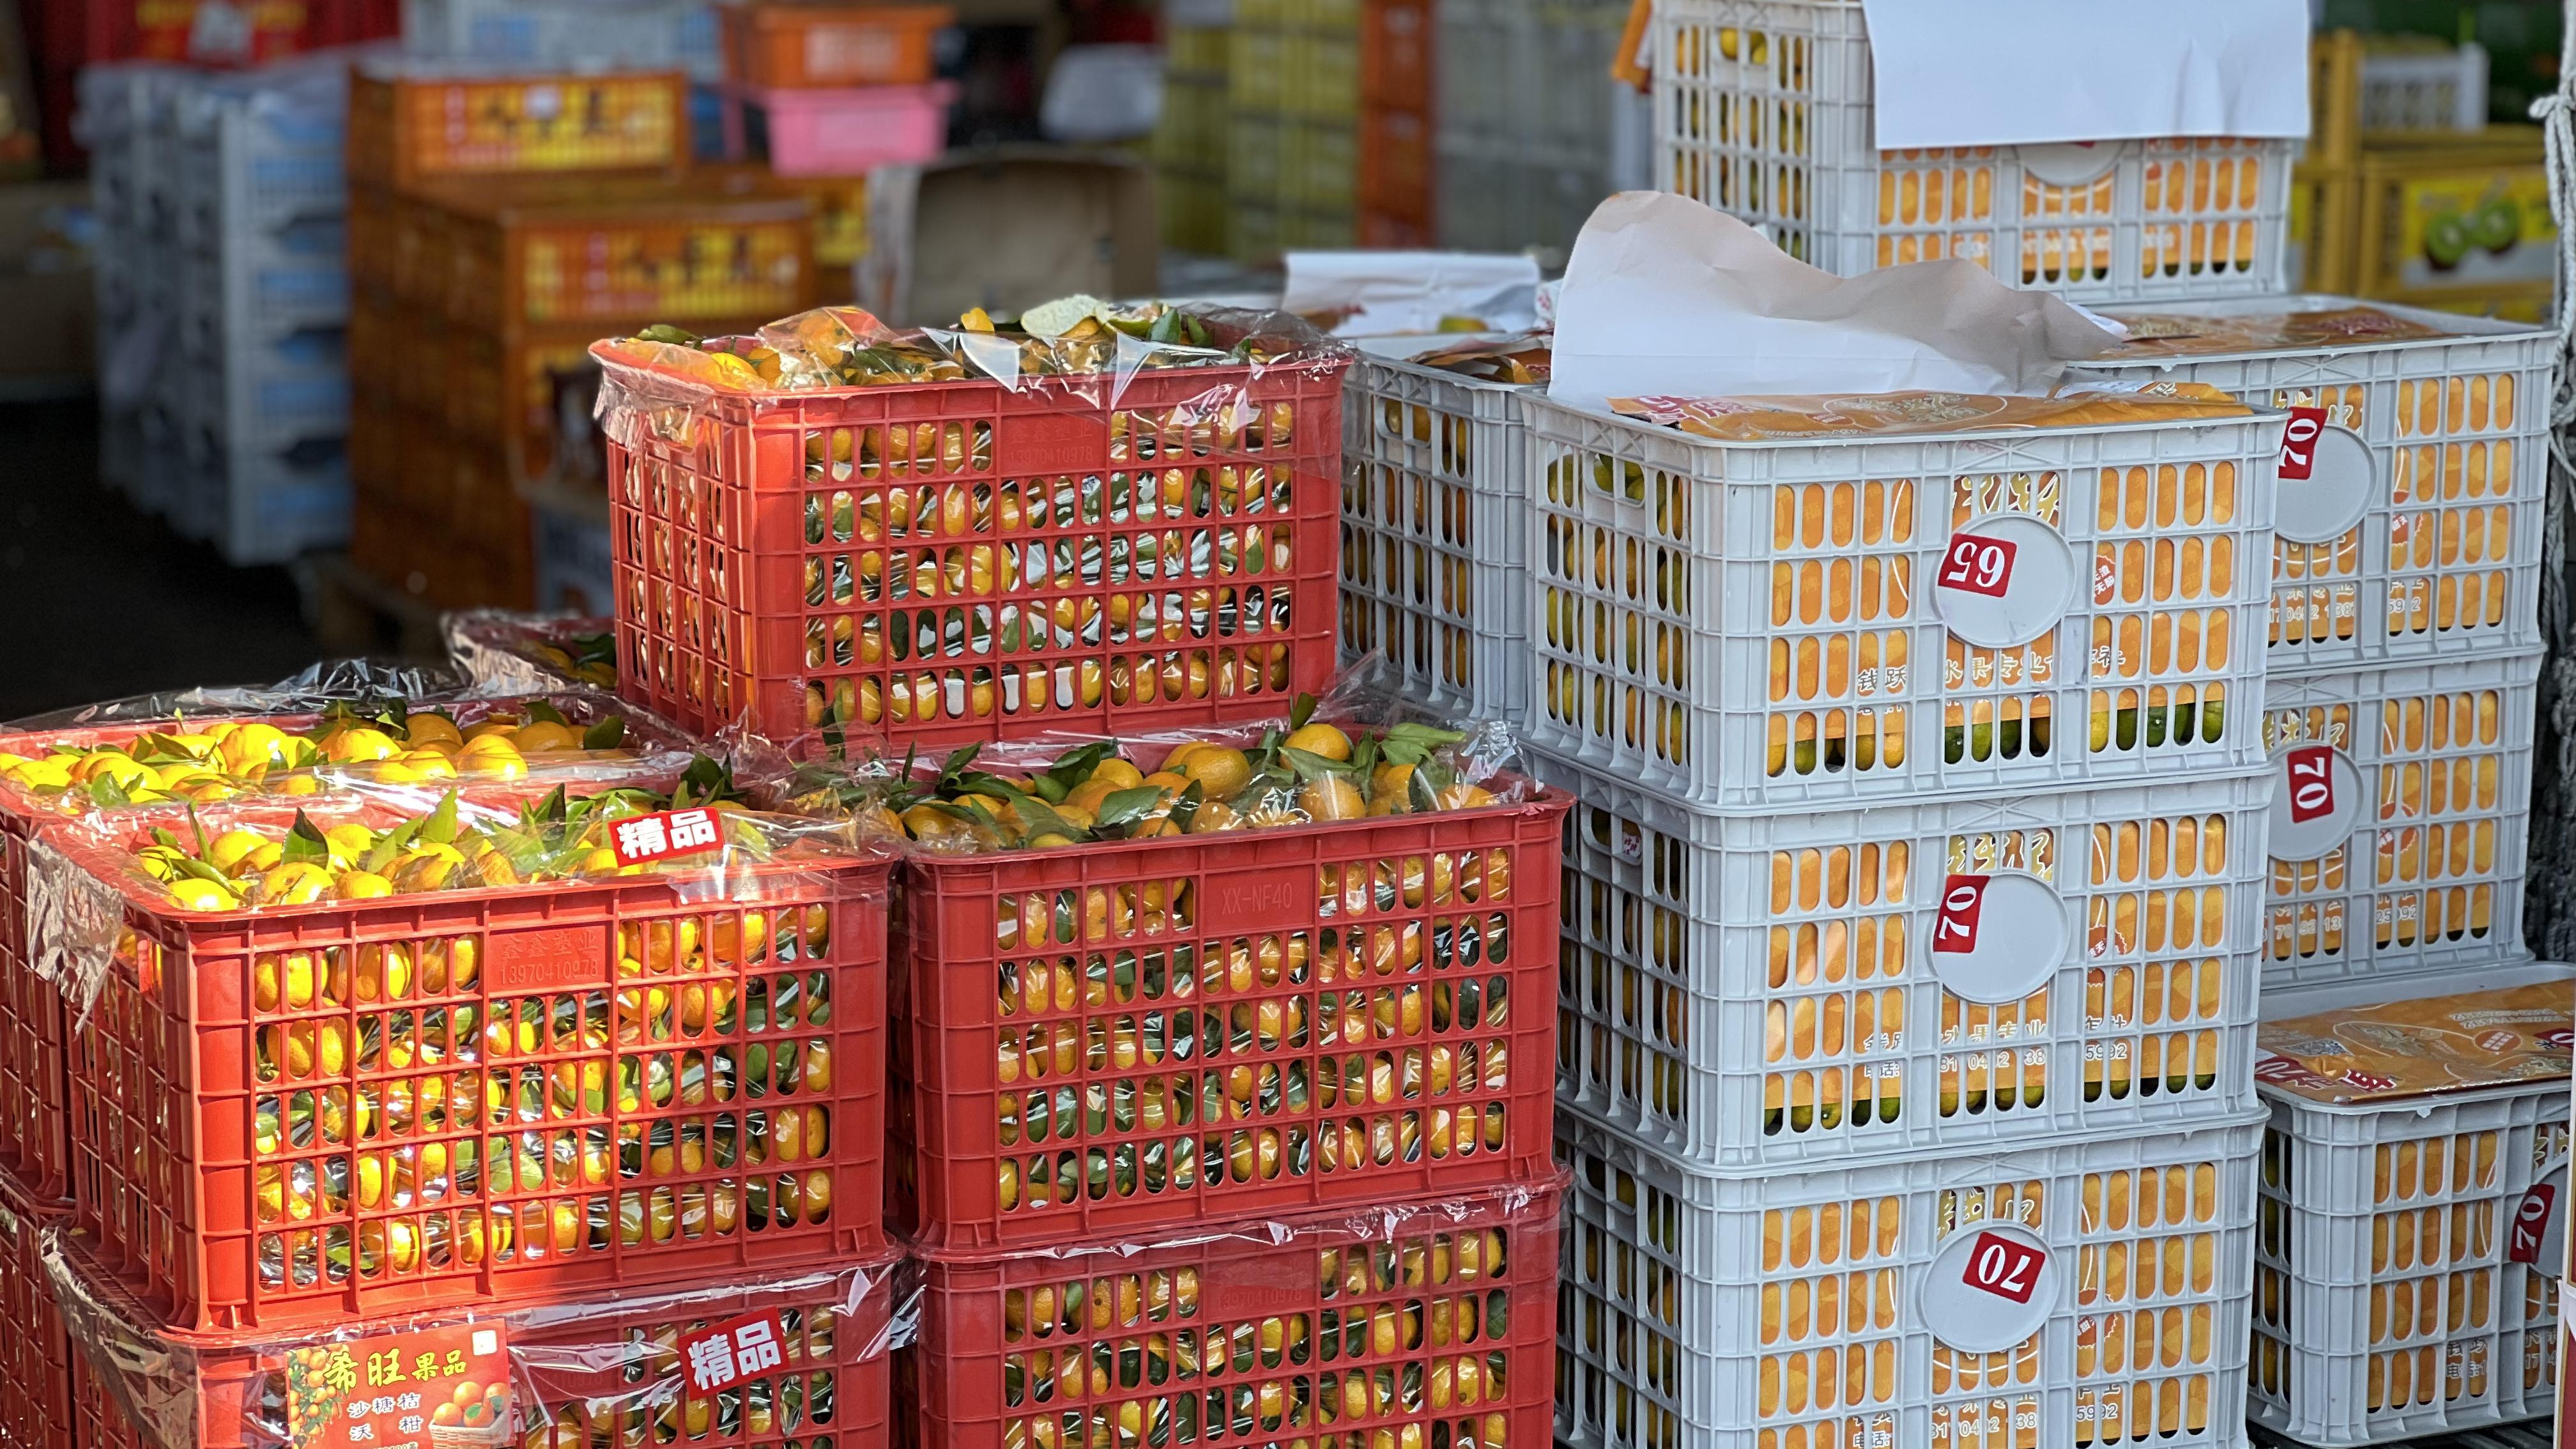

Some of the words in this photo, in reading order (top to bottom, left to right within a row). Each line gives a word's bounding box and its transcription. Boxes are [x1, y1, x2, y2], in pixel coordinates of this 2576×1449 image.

[2279, 418, 2318, 467] 70
[1947, 542, 2005, 587] 65
[2294, 757, 2328, 809] 70
[618, 809, 717, 859] 精品
[1222, 882, 1292, 916] XX-NF40
[1938, 885, 1977, 940] 70
[501, 928, 599, 962] 鑫鑫塑业
[500, 960, 599, 985] 13970410978
[2516, 1195, 2545, 1250] 70
[1978, 1244, 2031, 1292] 70
[687, 1319, 781, 1392] 精品
[348, 1392, 421, 1418] 沙糖桔
